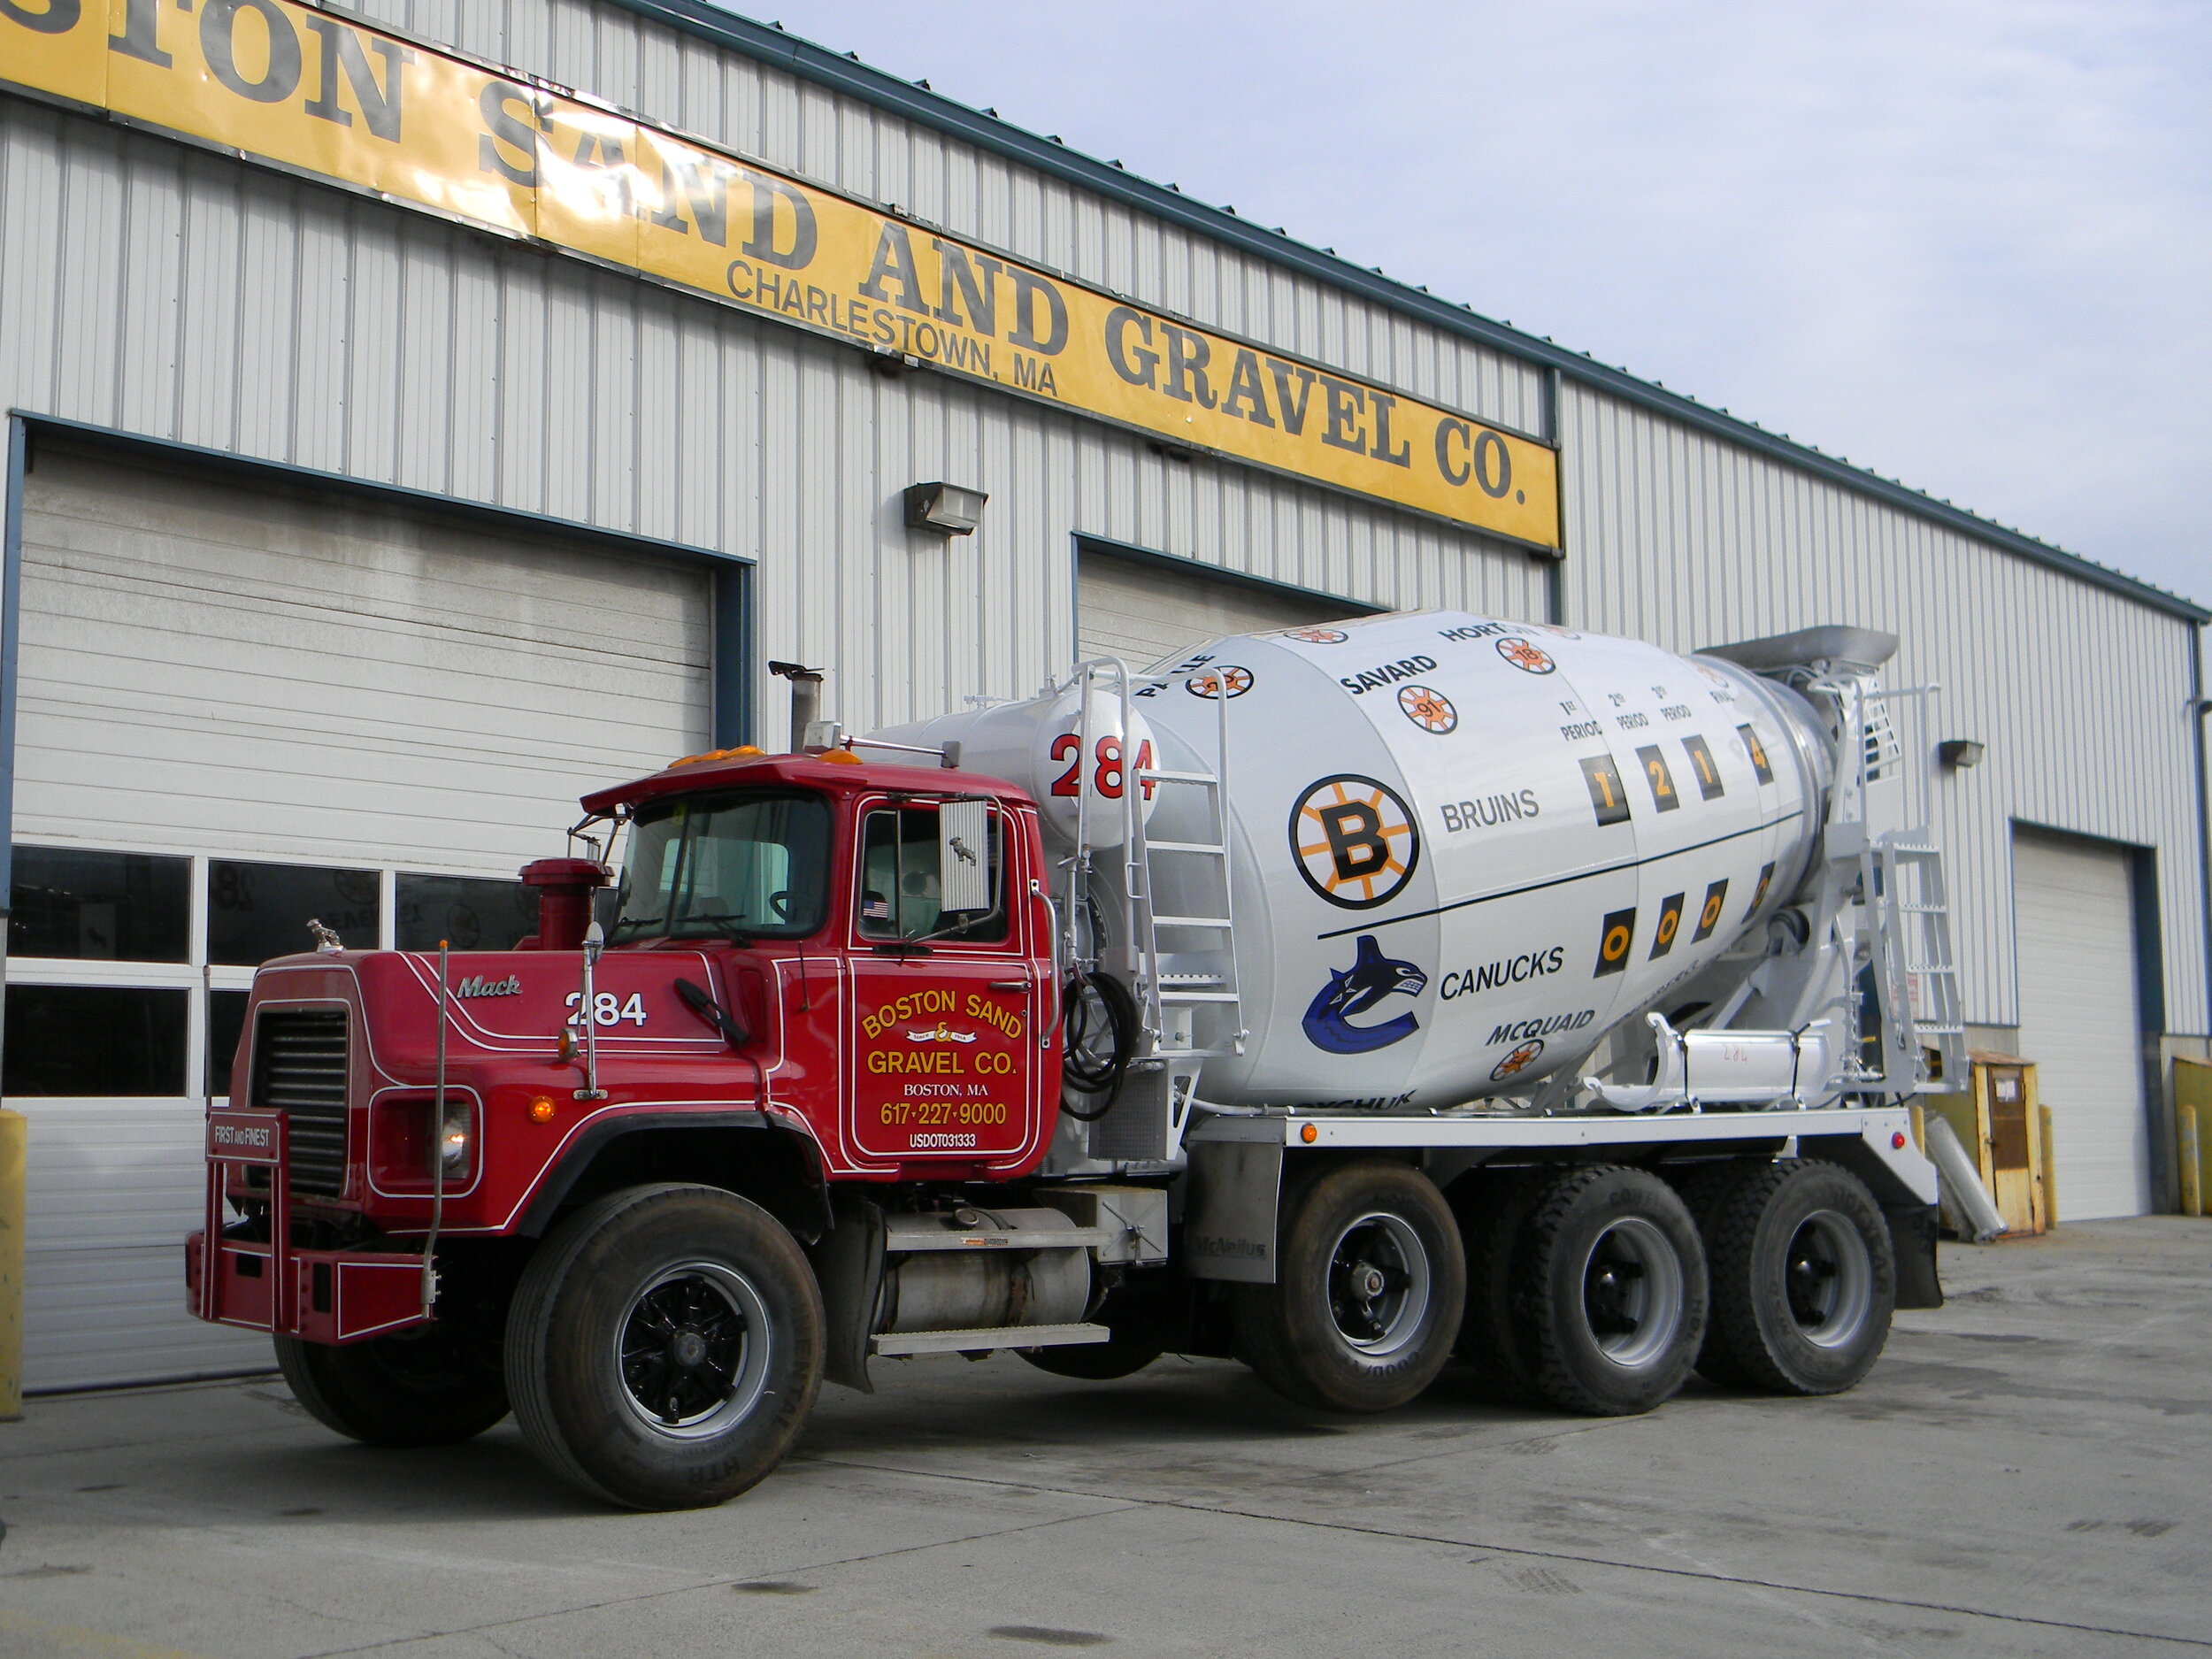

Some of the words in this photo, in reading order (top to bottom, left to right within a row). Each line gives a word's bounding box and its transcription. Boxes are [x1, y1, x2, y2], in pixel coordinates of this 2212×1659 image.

[726, 259, 999, 381] CHARLESTOWN,
[1013, 352, 1058, 397] MA
[859, 220, 1069, 356] AND
[1104, 305, 1411, 469] GRAVEL
[1434, 417, 1526, 506] CO.
[1514, 648, 1539, 662] 18
[1340, 654, 1438, 695] SAVARD
[1416, 699, 1442, 718] 91
[1559, 720, 1603, 742] PERIOD
[1615, 711, 1649, 731] PERIOD
[1660, 703, 1692, 722] PERIOD
[1050, 733, 1156, 802] 284
[1440, 788, 1540, 833] BRUINS
[1594, 771, 1615, 808] 1
[1648, 760, 1671, 796] 2
[1694, 749, 1713, 785] 1
[1750, 736, 1767, 770] 4
[1316, 798, 1393, 884] B
[457, 974, 524, 999] Mack
[1440, 946, 1564, 1002] CANUCKS
[564, 991, 648, 1026] 284
[861, 989, 956, 1041] BOSTON
[965, 993, 1023, 1040] SAND
[934, 1021, 953, 1043] &
[1485, 1009, 1596, 1047] MCQUAID
[866, 1049, 965, 1075] GRAVEL
[973, 1051, 1018, 1075] CO.
[903, 1084, 963, 1098] BOSTON,
[967, 1084, 989, 1097] MA
[214, 1125, 234, 1144] FIRST
[234, 1130, 245, 1145] AND
[244, 1127, 270, 1148] FINEST
[910, 1133, 977, 1148] USDOT031333
